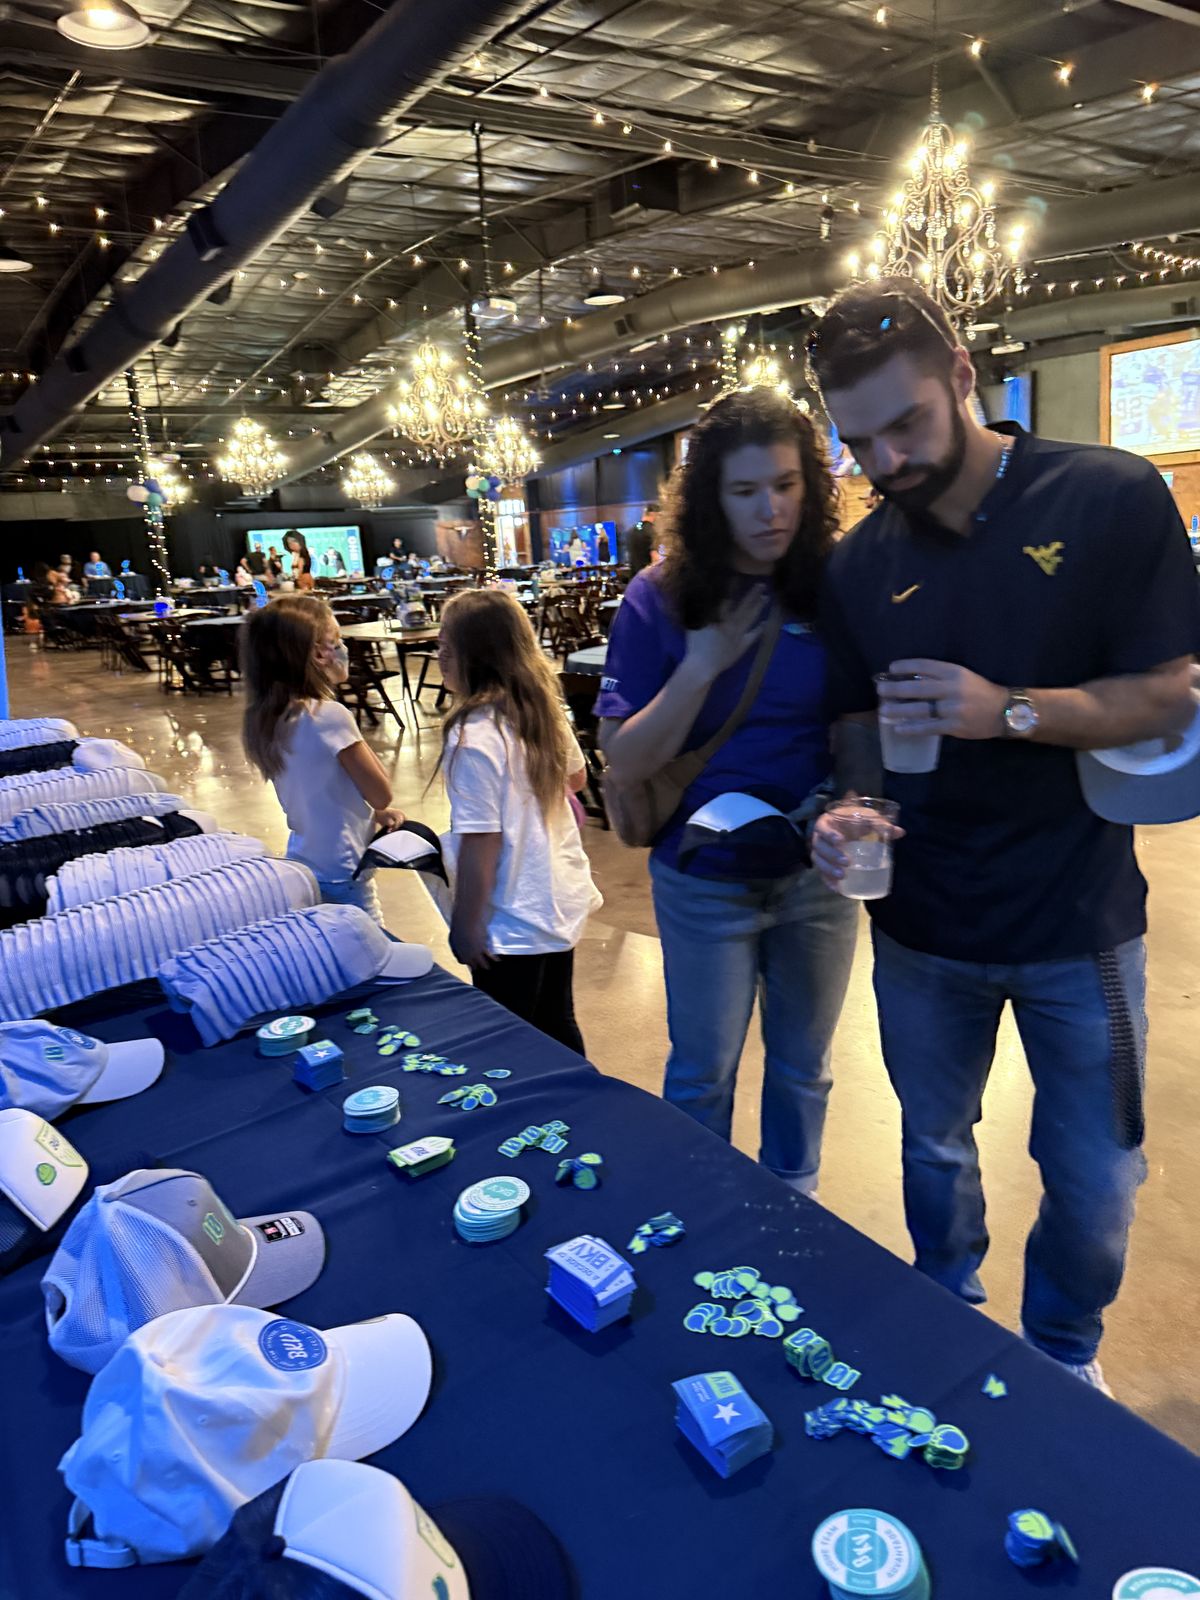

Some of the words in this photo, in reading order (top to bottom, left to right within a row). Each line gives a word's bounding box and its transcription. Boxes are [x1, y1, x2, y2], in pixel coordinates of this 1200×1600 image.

[567, 1242, 611, 1270] BKV
[820, 1525, 840, 1546] TEAM
[851, 1533, 873, 1568] BKV
